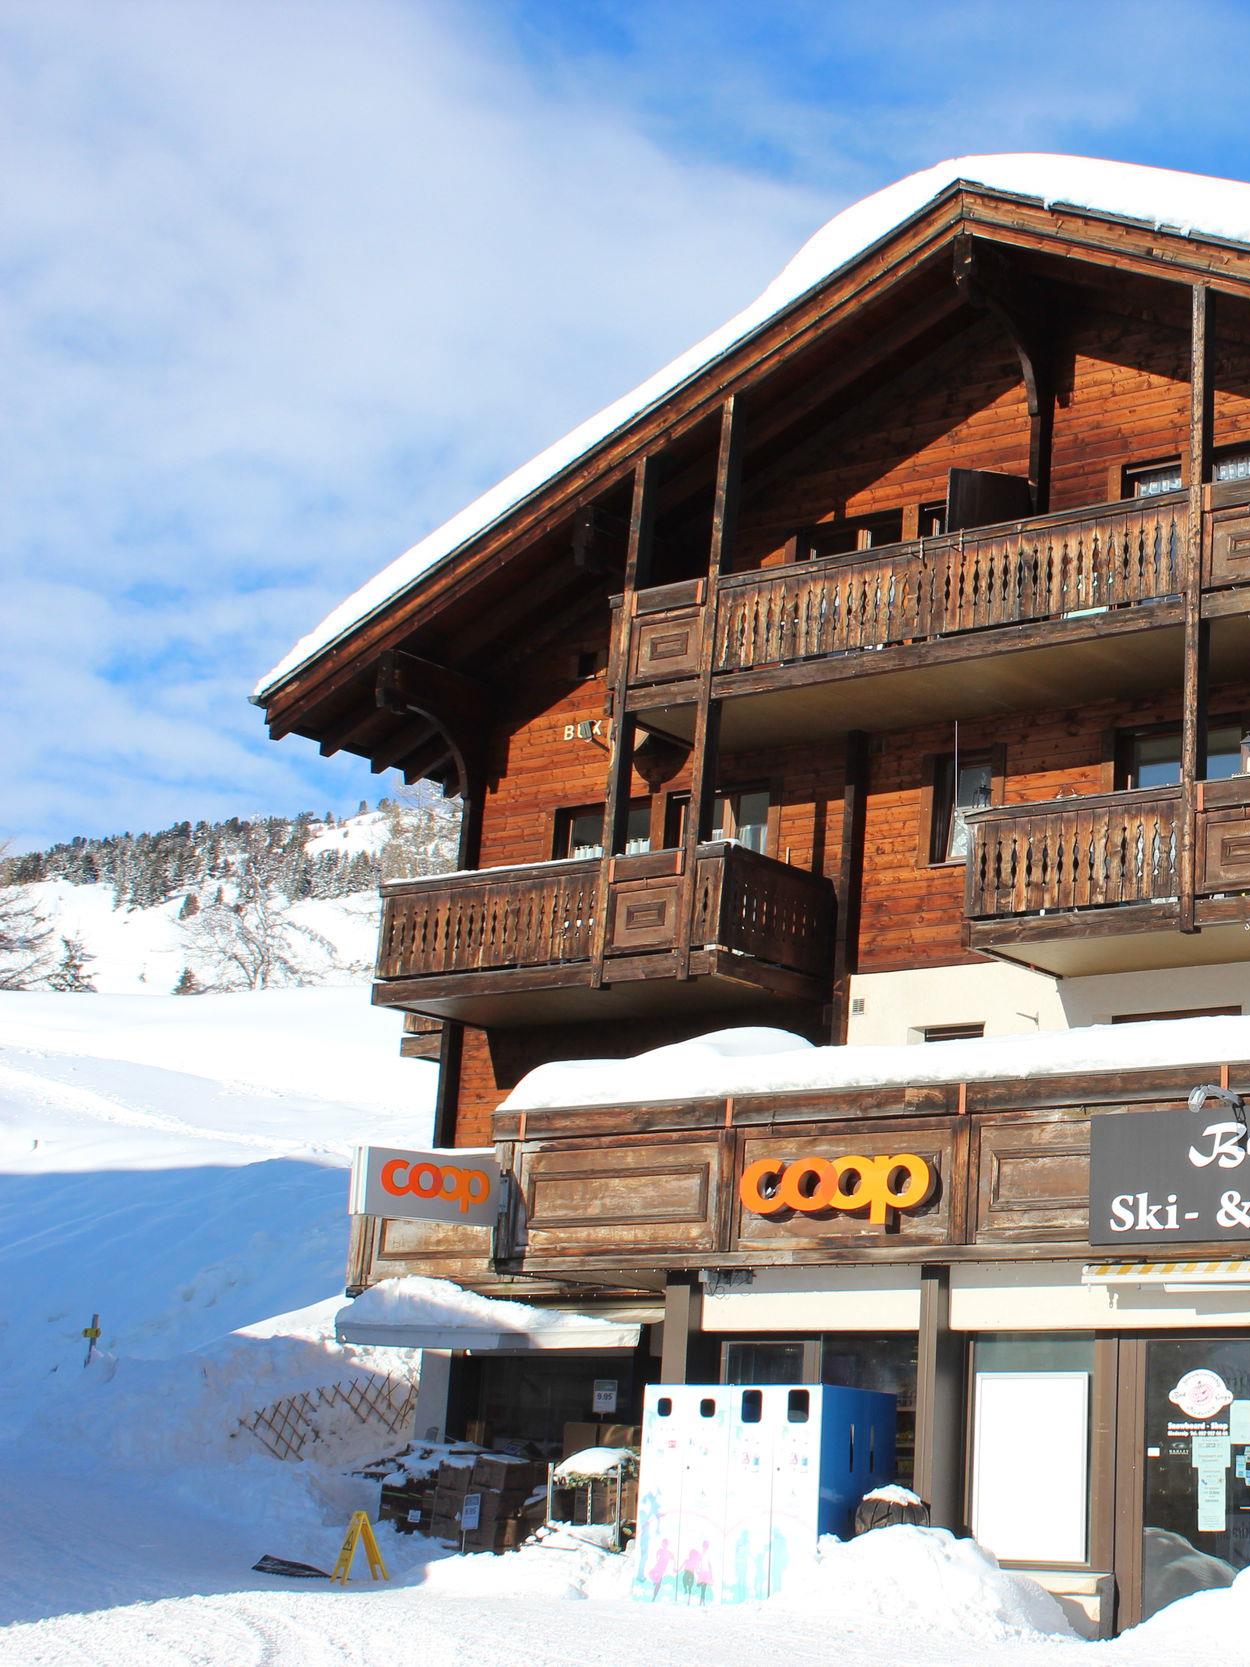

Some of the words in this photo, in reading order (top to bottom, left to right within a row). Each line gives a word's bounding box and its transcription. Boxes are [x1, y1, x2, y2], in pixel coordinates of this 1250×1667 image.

[381, 1159, 490, 1212] coop
[739, 1153, 930, 1225] coop
[1110, 1191, 1199, 1231] Ski-
[1210, 1421, 1228, 1431] Shop
